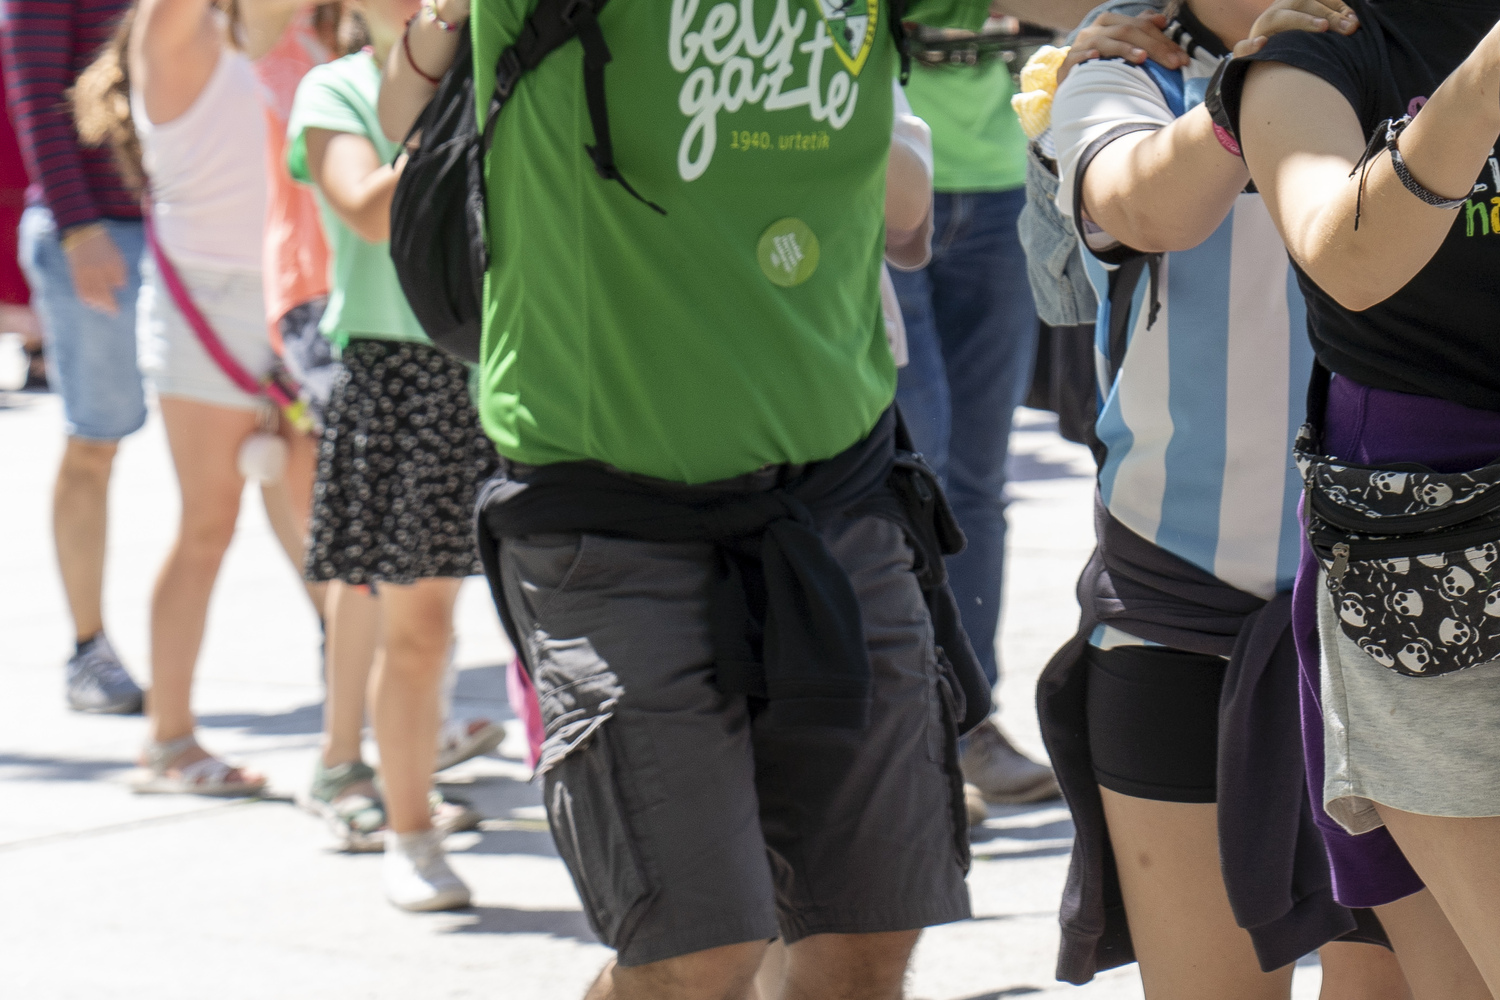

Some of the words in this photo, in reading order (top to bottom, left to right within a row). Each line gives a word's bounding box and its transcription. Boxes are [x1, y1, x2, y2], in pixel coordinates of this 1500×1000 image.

[678, 20, 859, 182] gazte
[730, 131, 774, 151] 1940.
[778, 131, 830, 150] urtetik
